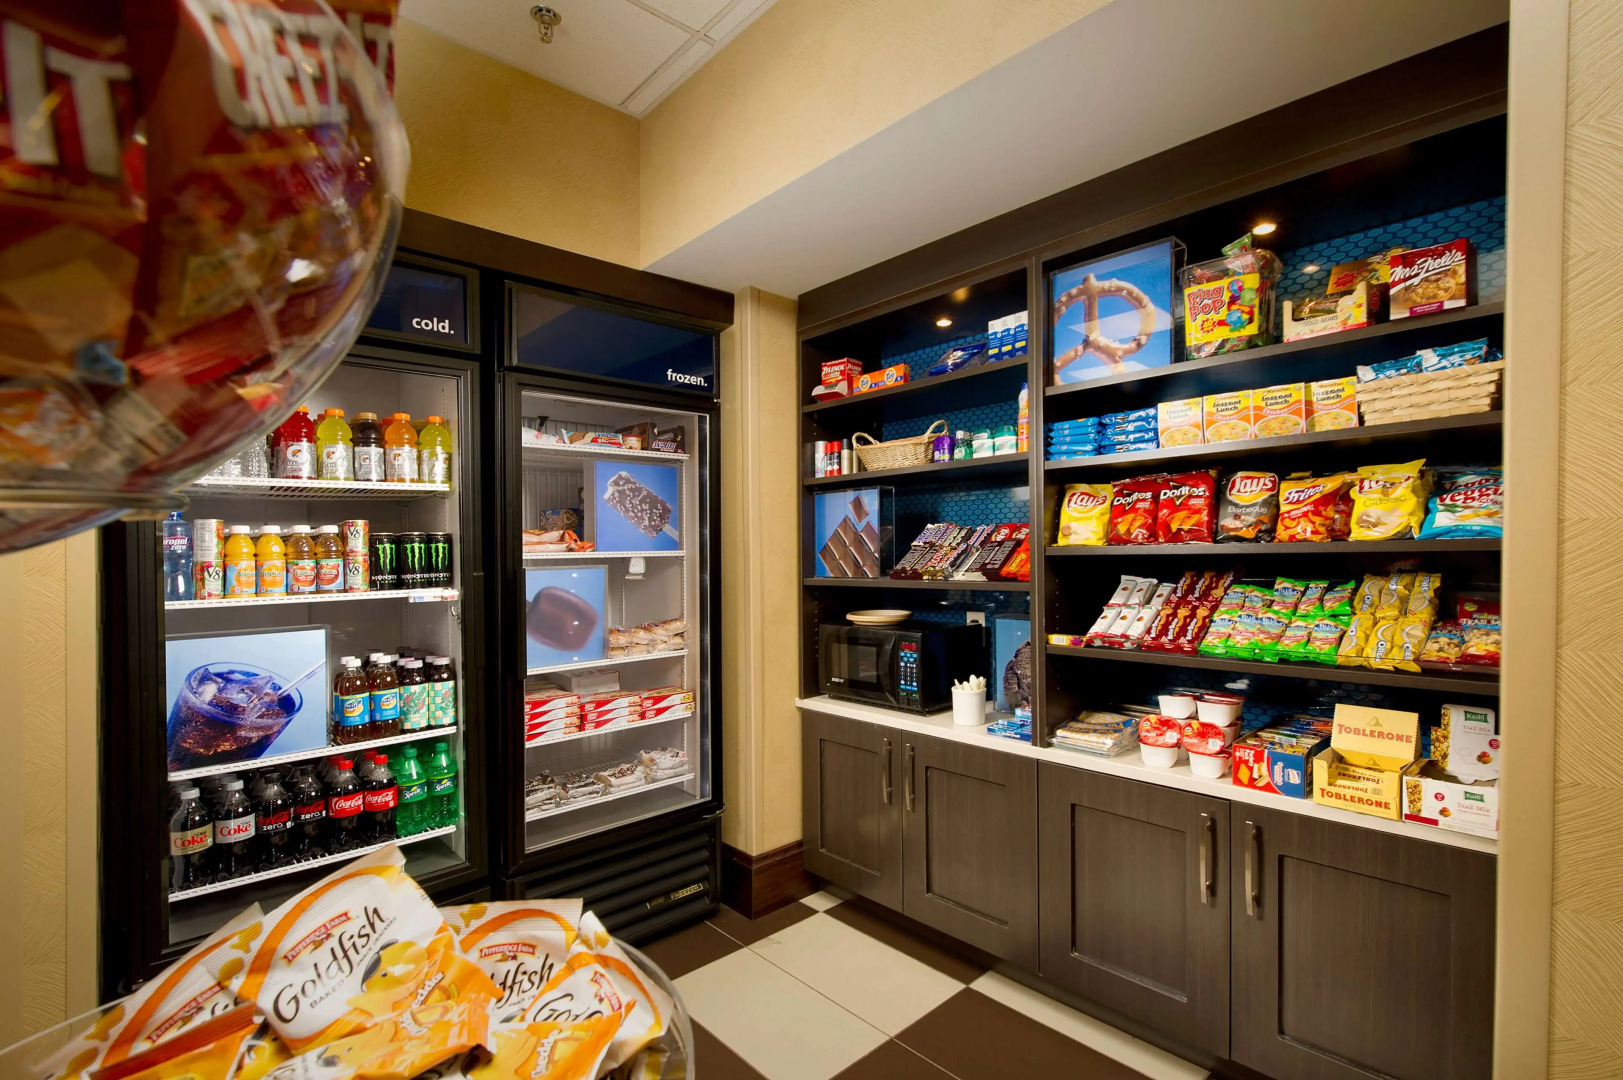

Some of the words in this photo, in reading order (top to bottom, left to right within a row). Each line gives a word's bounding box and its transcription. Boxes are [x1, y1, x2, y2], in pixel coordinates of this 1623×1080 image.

[1413, 249, 1466, 285] Fields
[1187, 285, 1224, 306] Ring
[412, 316, 454, 335] cold.
[667, 368, 708, 387] frozen.
[1262, 392, 1293, 404] Instant
[1312, 387, 1345, 398] Instant
[1316, 393, 1343, 404] Lunch
[1213, 399, 1242, 409] Instant
[1216, 406, 1239, 414] Lunch
[1265, 398, 1290, 408] Lunch
[1166, 407, 1192, 417] Instant
[1169, 413, 1189, 422] Lunch
[1113, 491, 1153, 506] Doritos
[1160, 487, 1210, 500] Doritos
[1283, 483, 1327, 505] Fritos
[347, 526, 361, 542] V8
[204, 566, 221, 582] V8
[347, 563, 361, 577] V8
[1467, 711, 1486, 721] Kashi
[1337, 718, 1412, 744] TOBLERONE
[404, 787, 421, 800] Sprite
[435, 781, 452, 794] Sprite
[336, 795, 363, 811] Coca-Cola
[366, 790, 393, 804] Coca-Cola
[1319, 788, 1391, 811] TOBLERONE
[219, 823, 251, 839] Coke
[173, 832, 208, 849] Coke
[325, 912, 349, 935] FARM
[272, 904, 388, 1024] Goldfish
[309, 978, 345, 1010] BAKED
